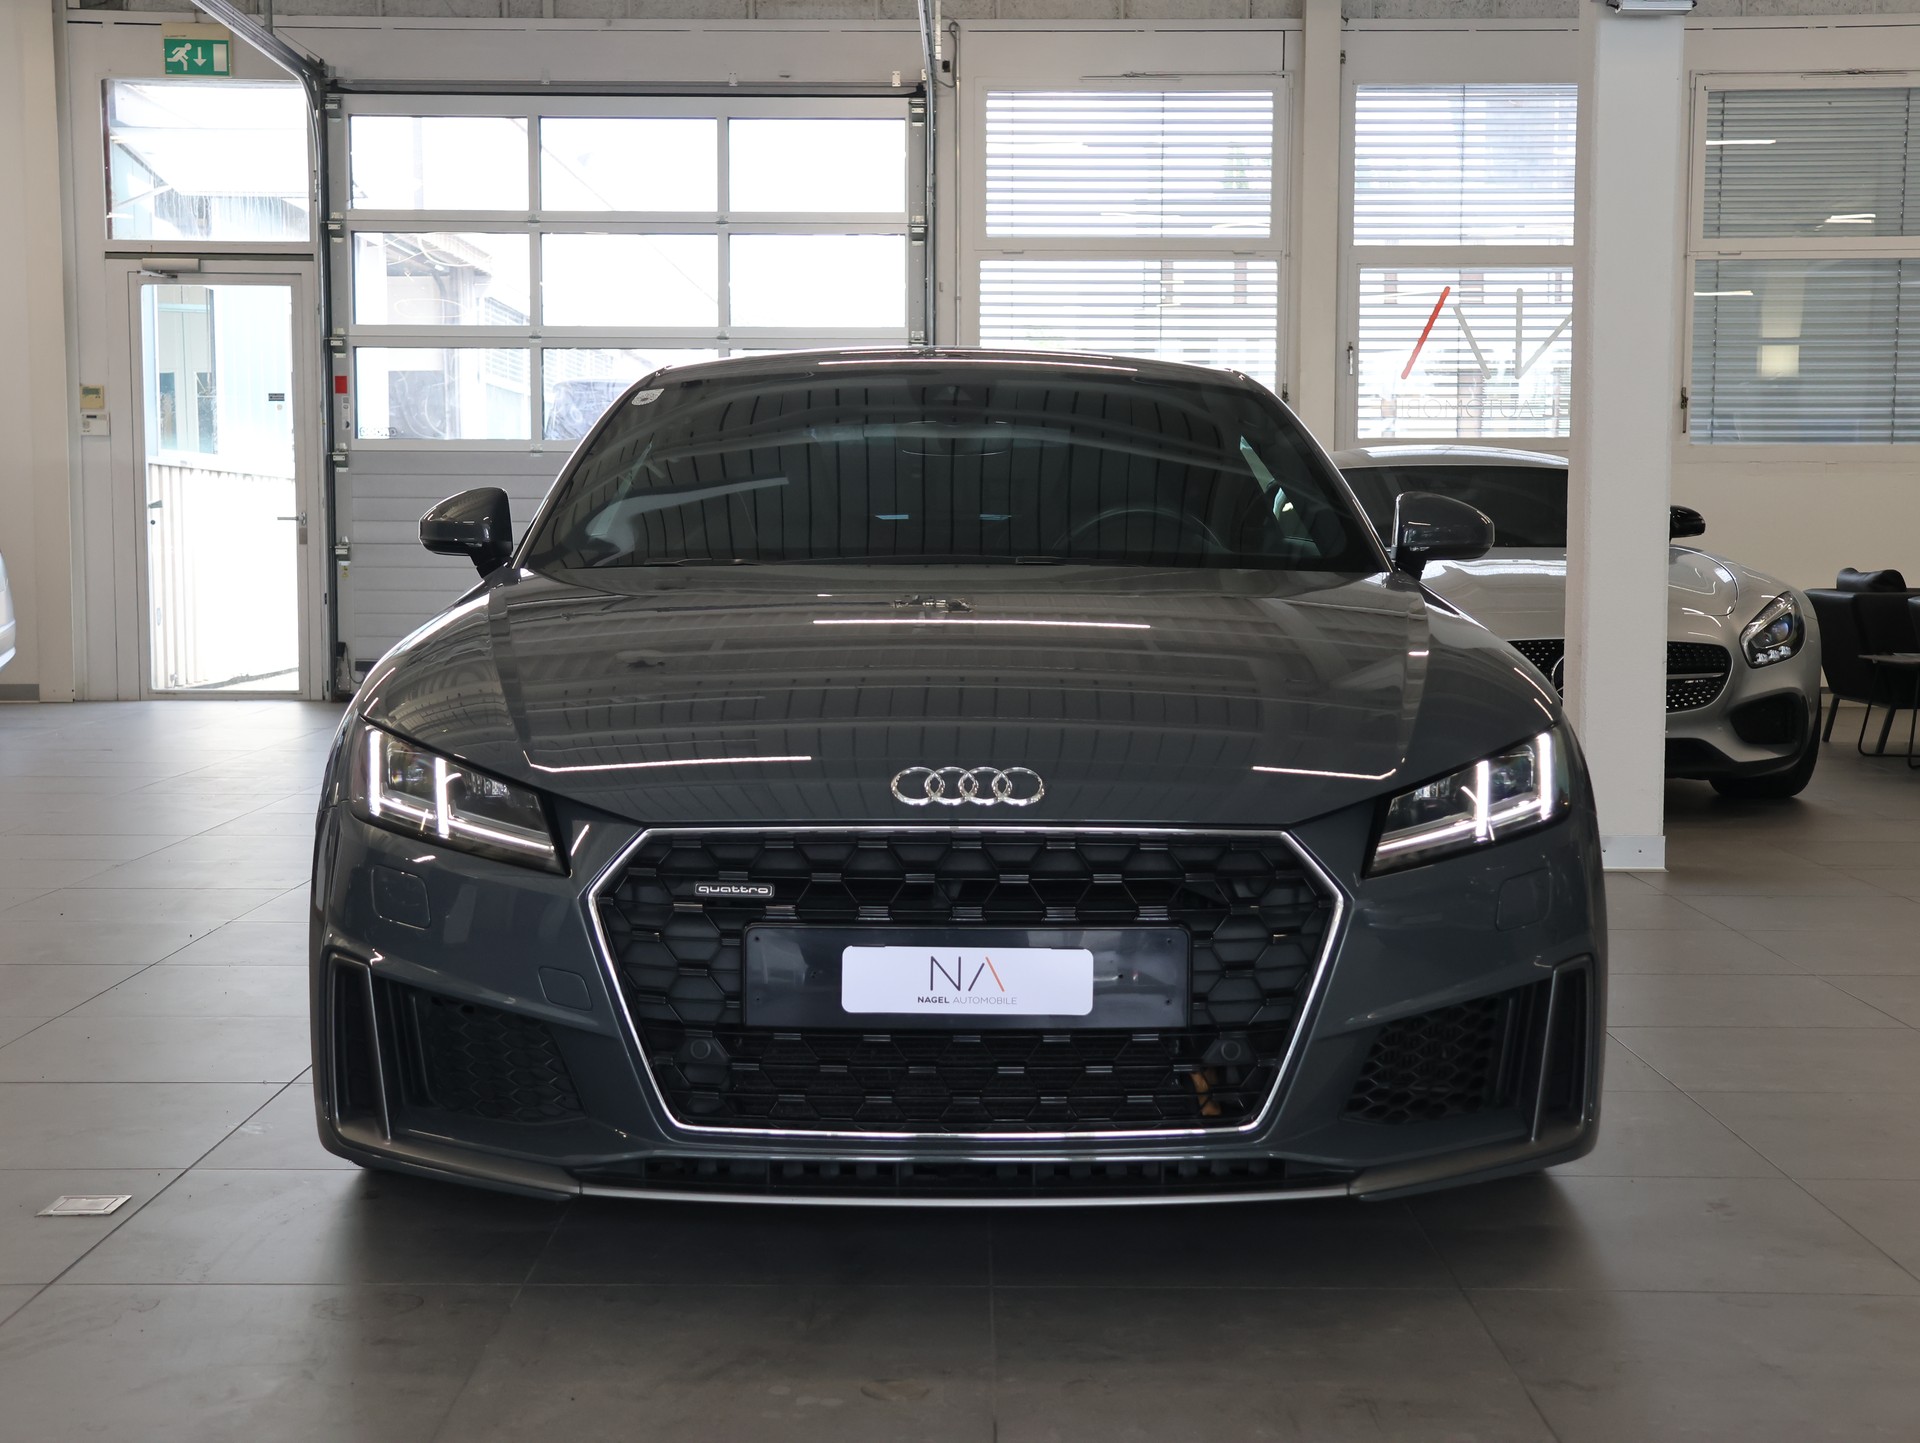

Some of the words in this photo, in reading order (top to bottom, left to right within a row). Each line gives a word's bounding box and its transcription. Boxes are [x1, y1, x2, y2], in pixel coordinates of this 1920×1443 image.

[698, 885, 769, 895] quattro
[917, 996, 950, 1005] NAGEL
[952, 996, 1018, 1006] AUTOMOBILE
